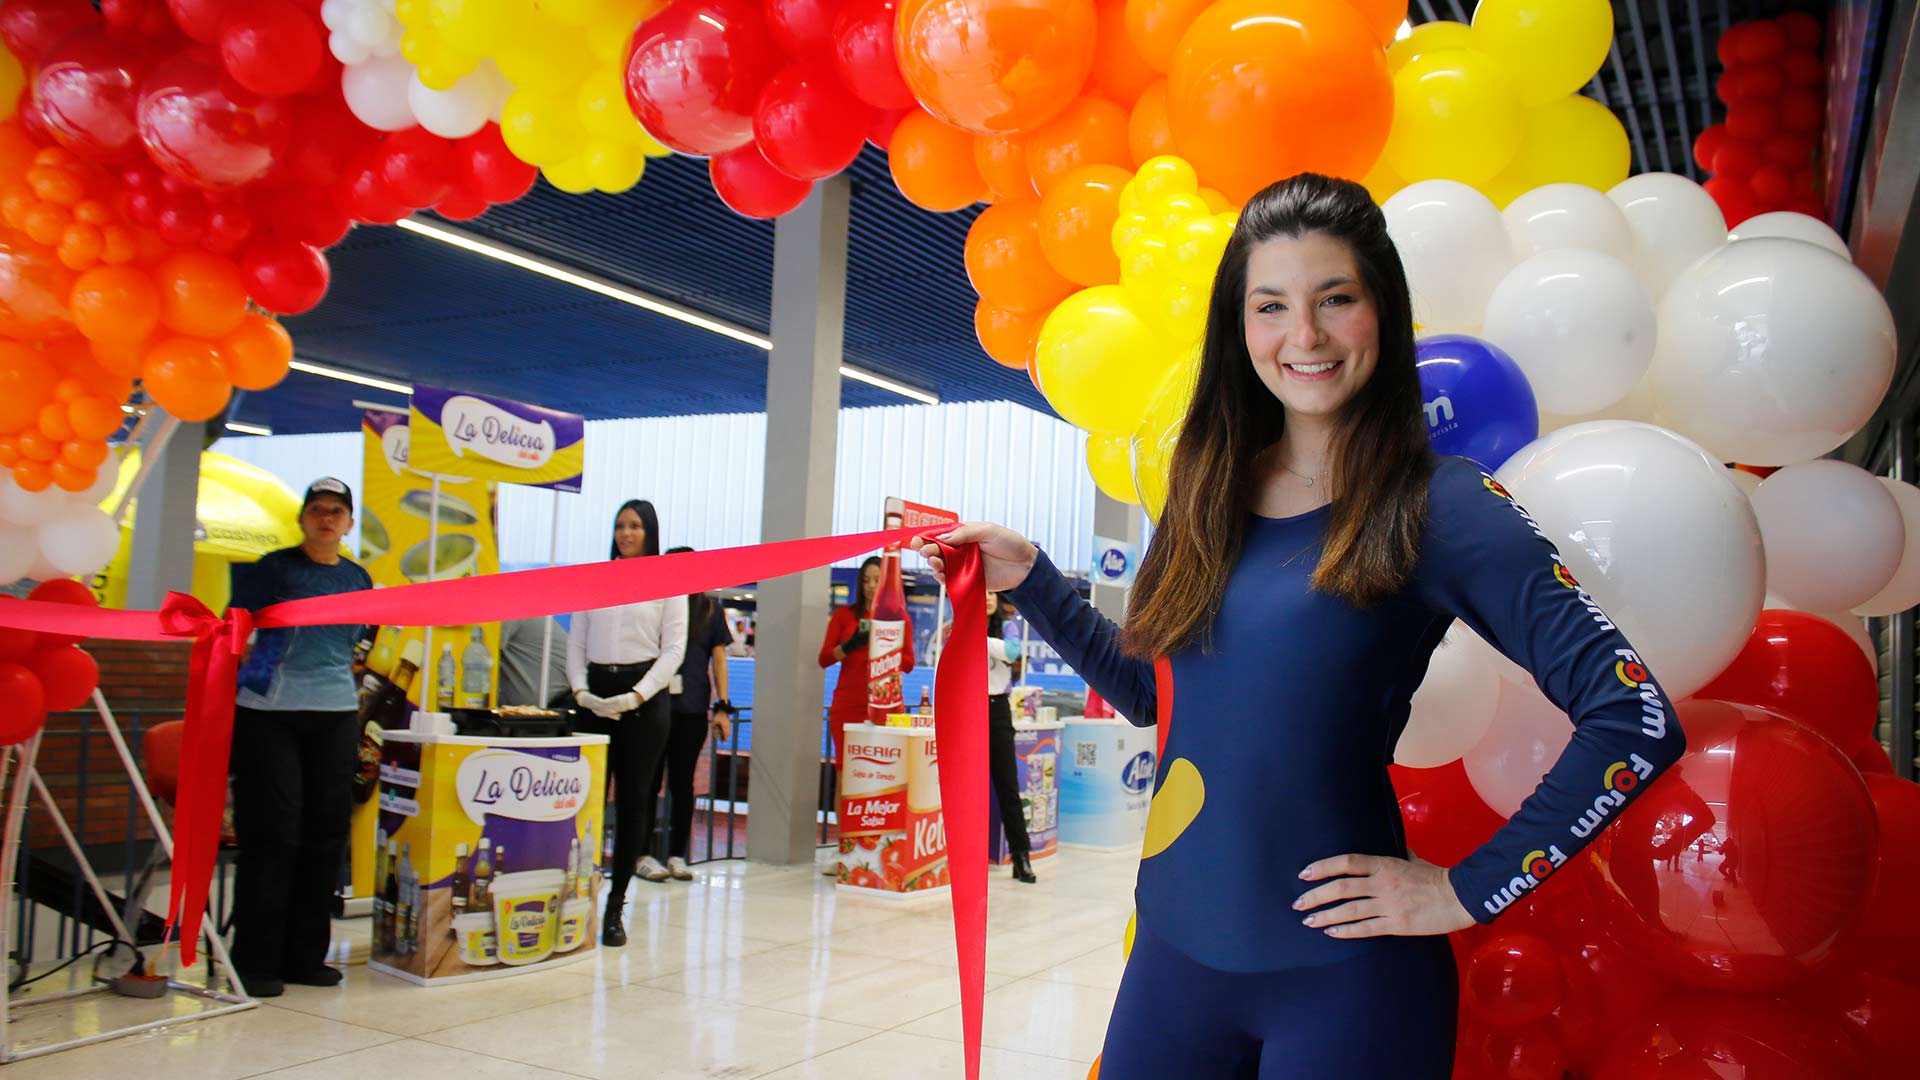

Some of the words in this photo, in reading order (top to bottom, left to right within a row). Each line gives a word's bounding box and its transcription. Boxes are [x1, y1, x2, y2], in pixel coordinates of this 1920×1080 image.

[453, 413, 477, 442] La
[482, 415, 545, 451] Delicia
[1615, 648, 1667, 740] Forum
[848, 744, 902, 759] IBERIA
[473, 769, 504, 805] La
[510, 766, 582, 801] Delicia
[1570, 753, 1654, 838] Forum
[846, 801, 863, 816] La
[864, 800, 901, 816] Mejor
[1484, 845, 1568, 915] Forum
